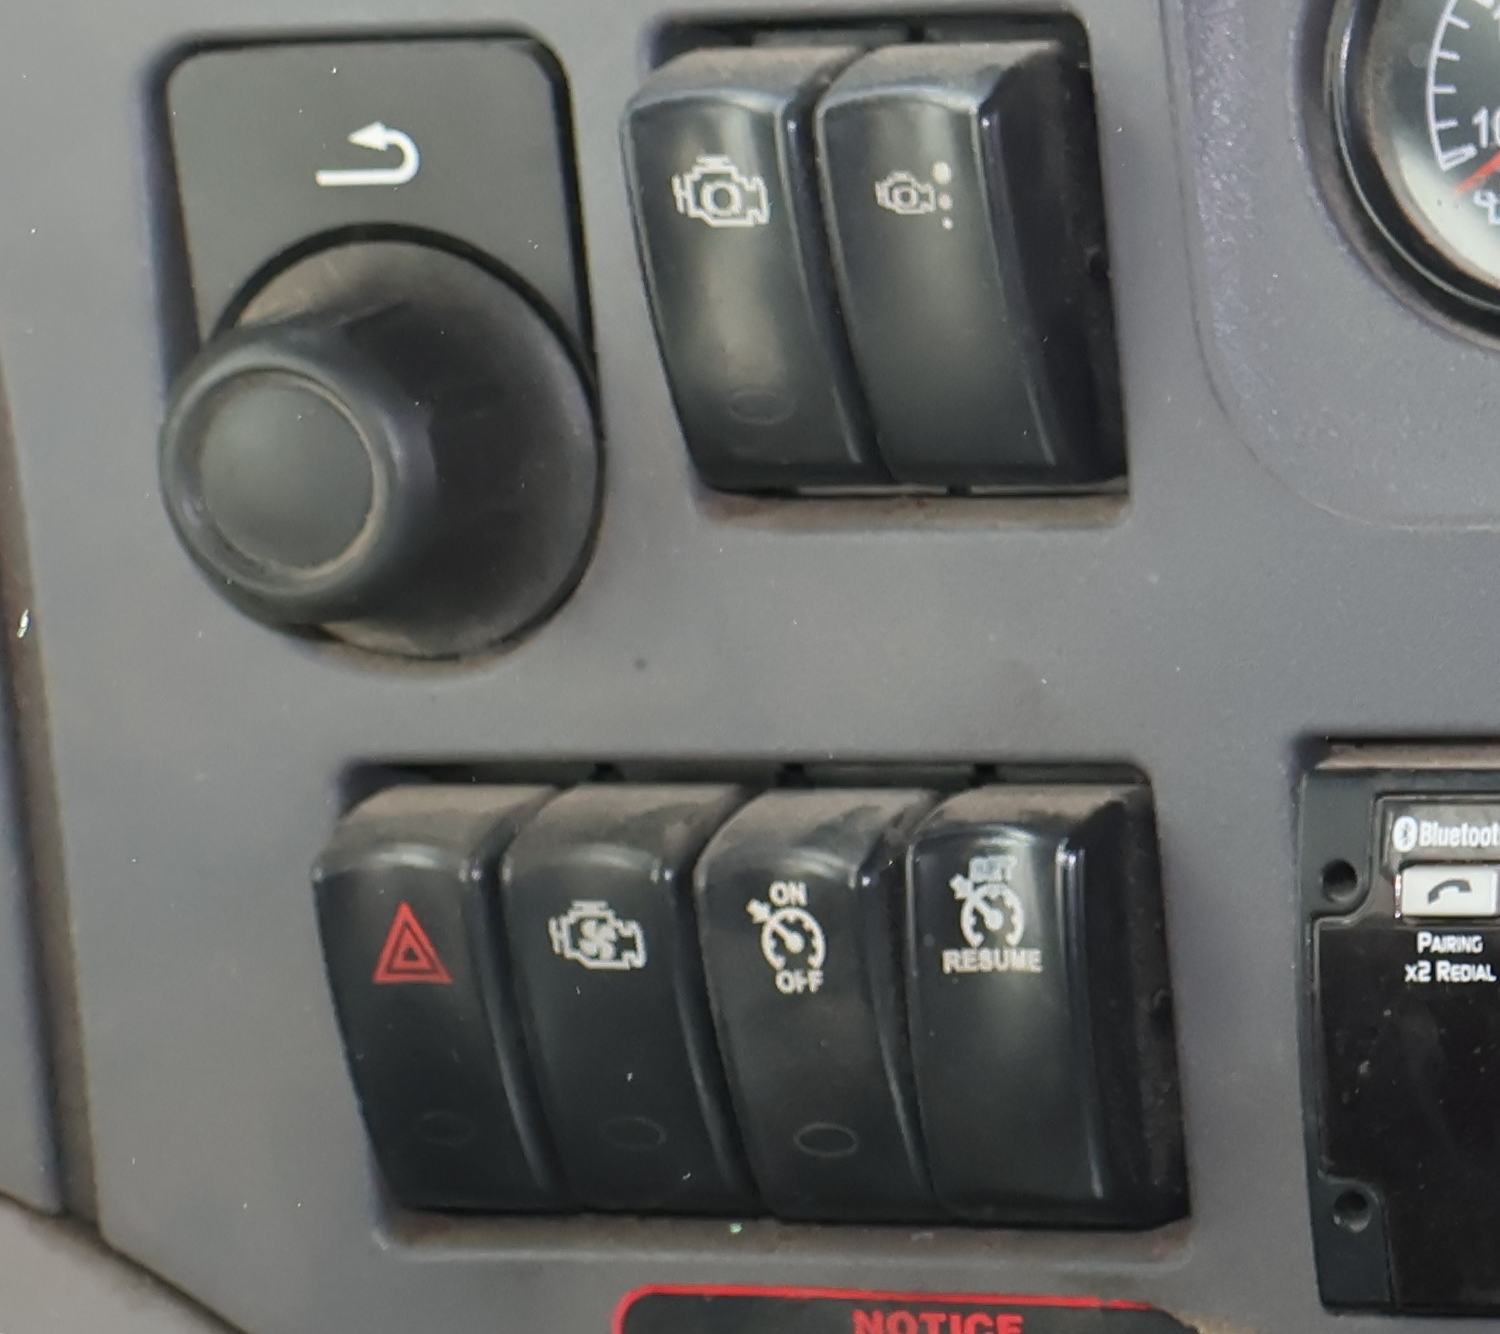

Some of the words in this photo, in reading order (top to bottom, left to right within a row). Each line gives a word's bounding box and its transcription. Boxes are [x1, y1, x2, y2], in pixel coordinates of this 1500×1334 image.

[769, 881, 808, 907] ON
[942, 947, 1043, 974] RESUME
[1404, 960, 1431, 983] x2
[775, 970, 825, 995] OFF
